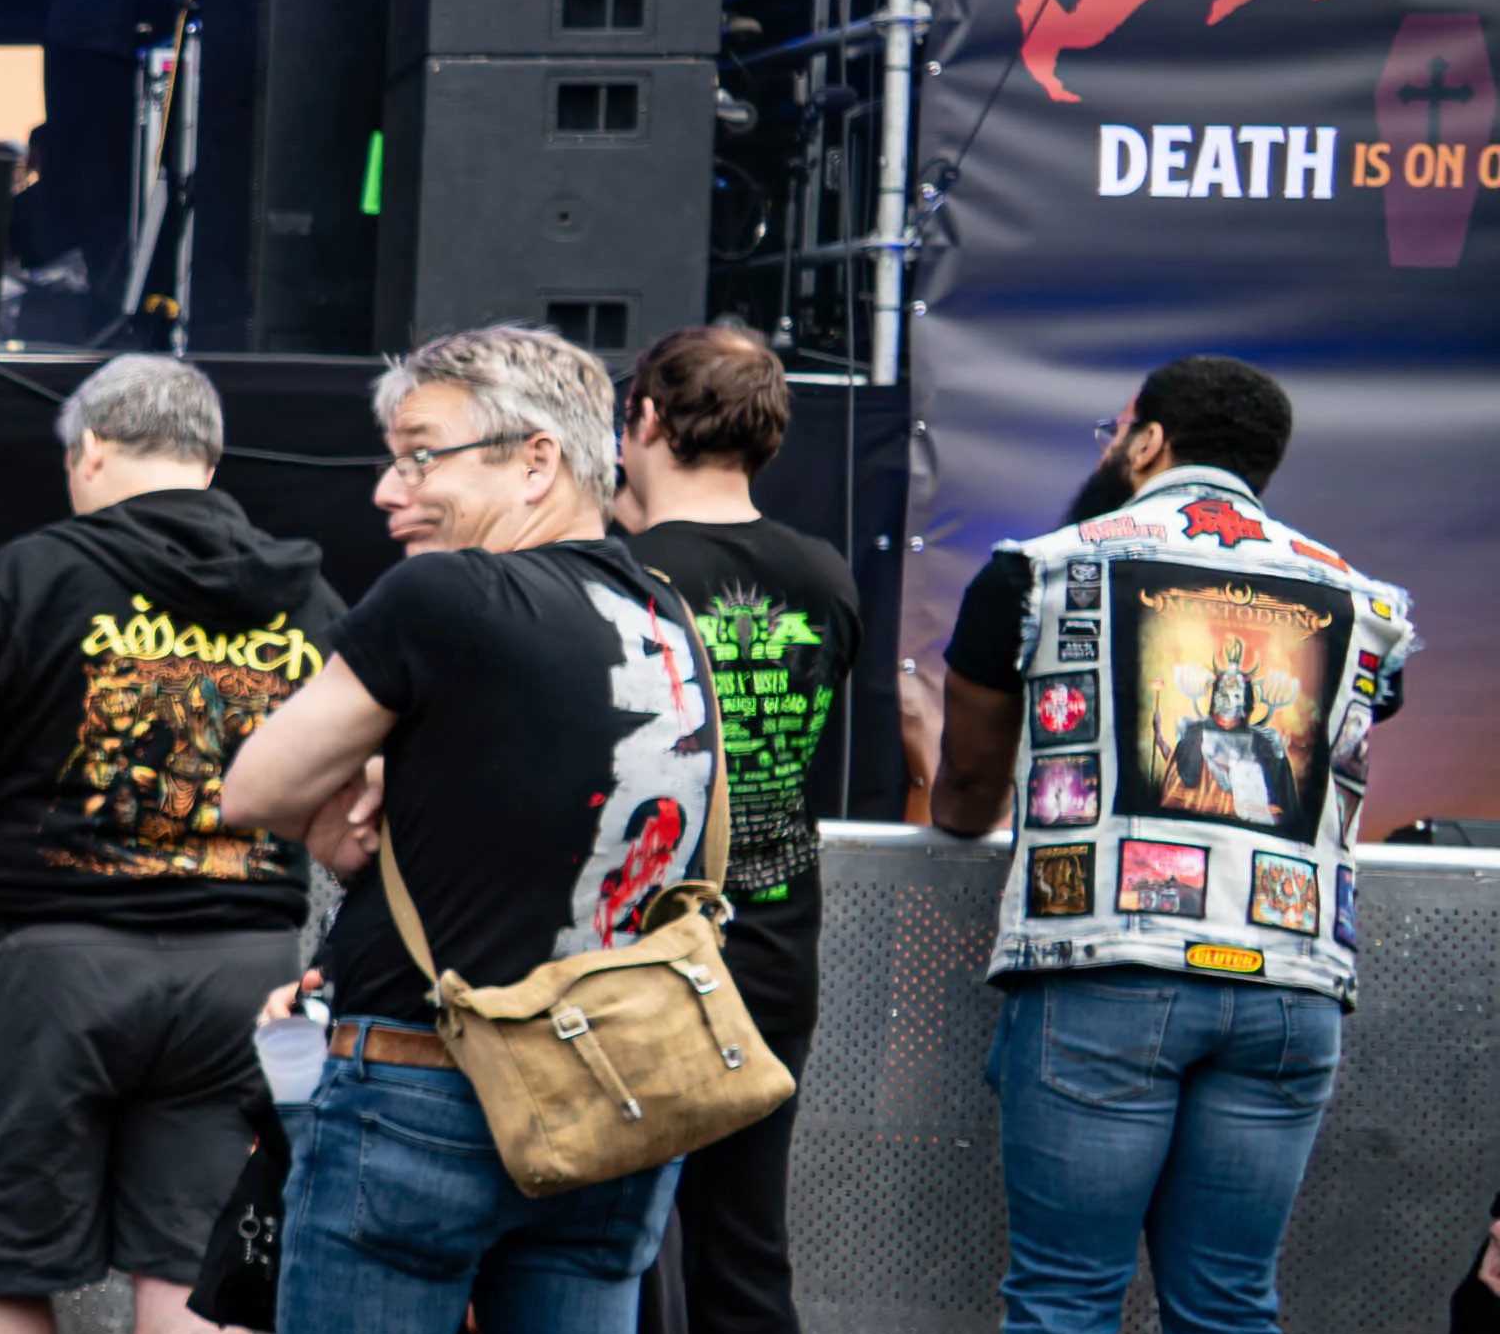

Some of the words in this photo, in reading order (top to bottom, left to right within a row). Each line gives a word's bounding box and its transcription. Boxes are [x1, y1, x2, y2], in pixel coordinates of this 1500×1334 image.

[1099, 124, 1338, 200] DEATH
[1352, 142, 1391, 189] IS
[1404, 142, 1465, 189] ON
